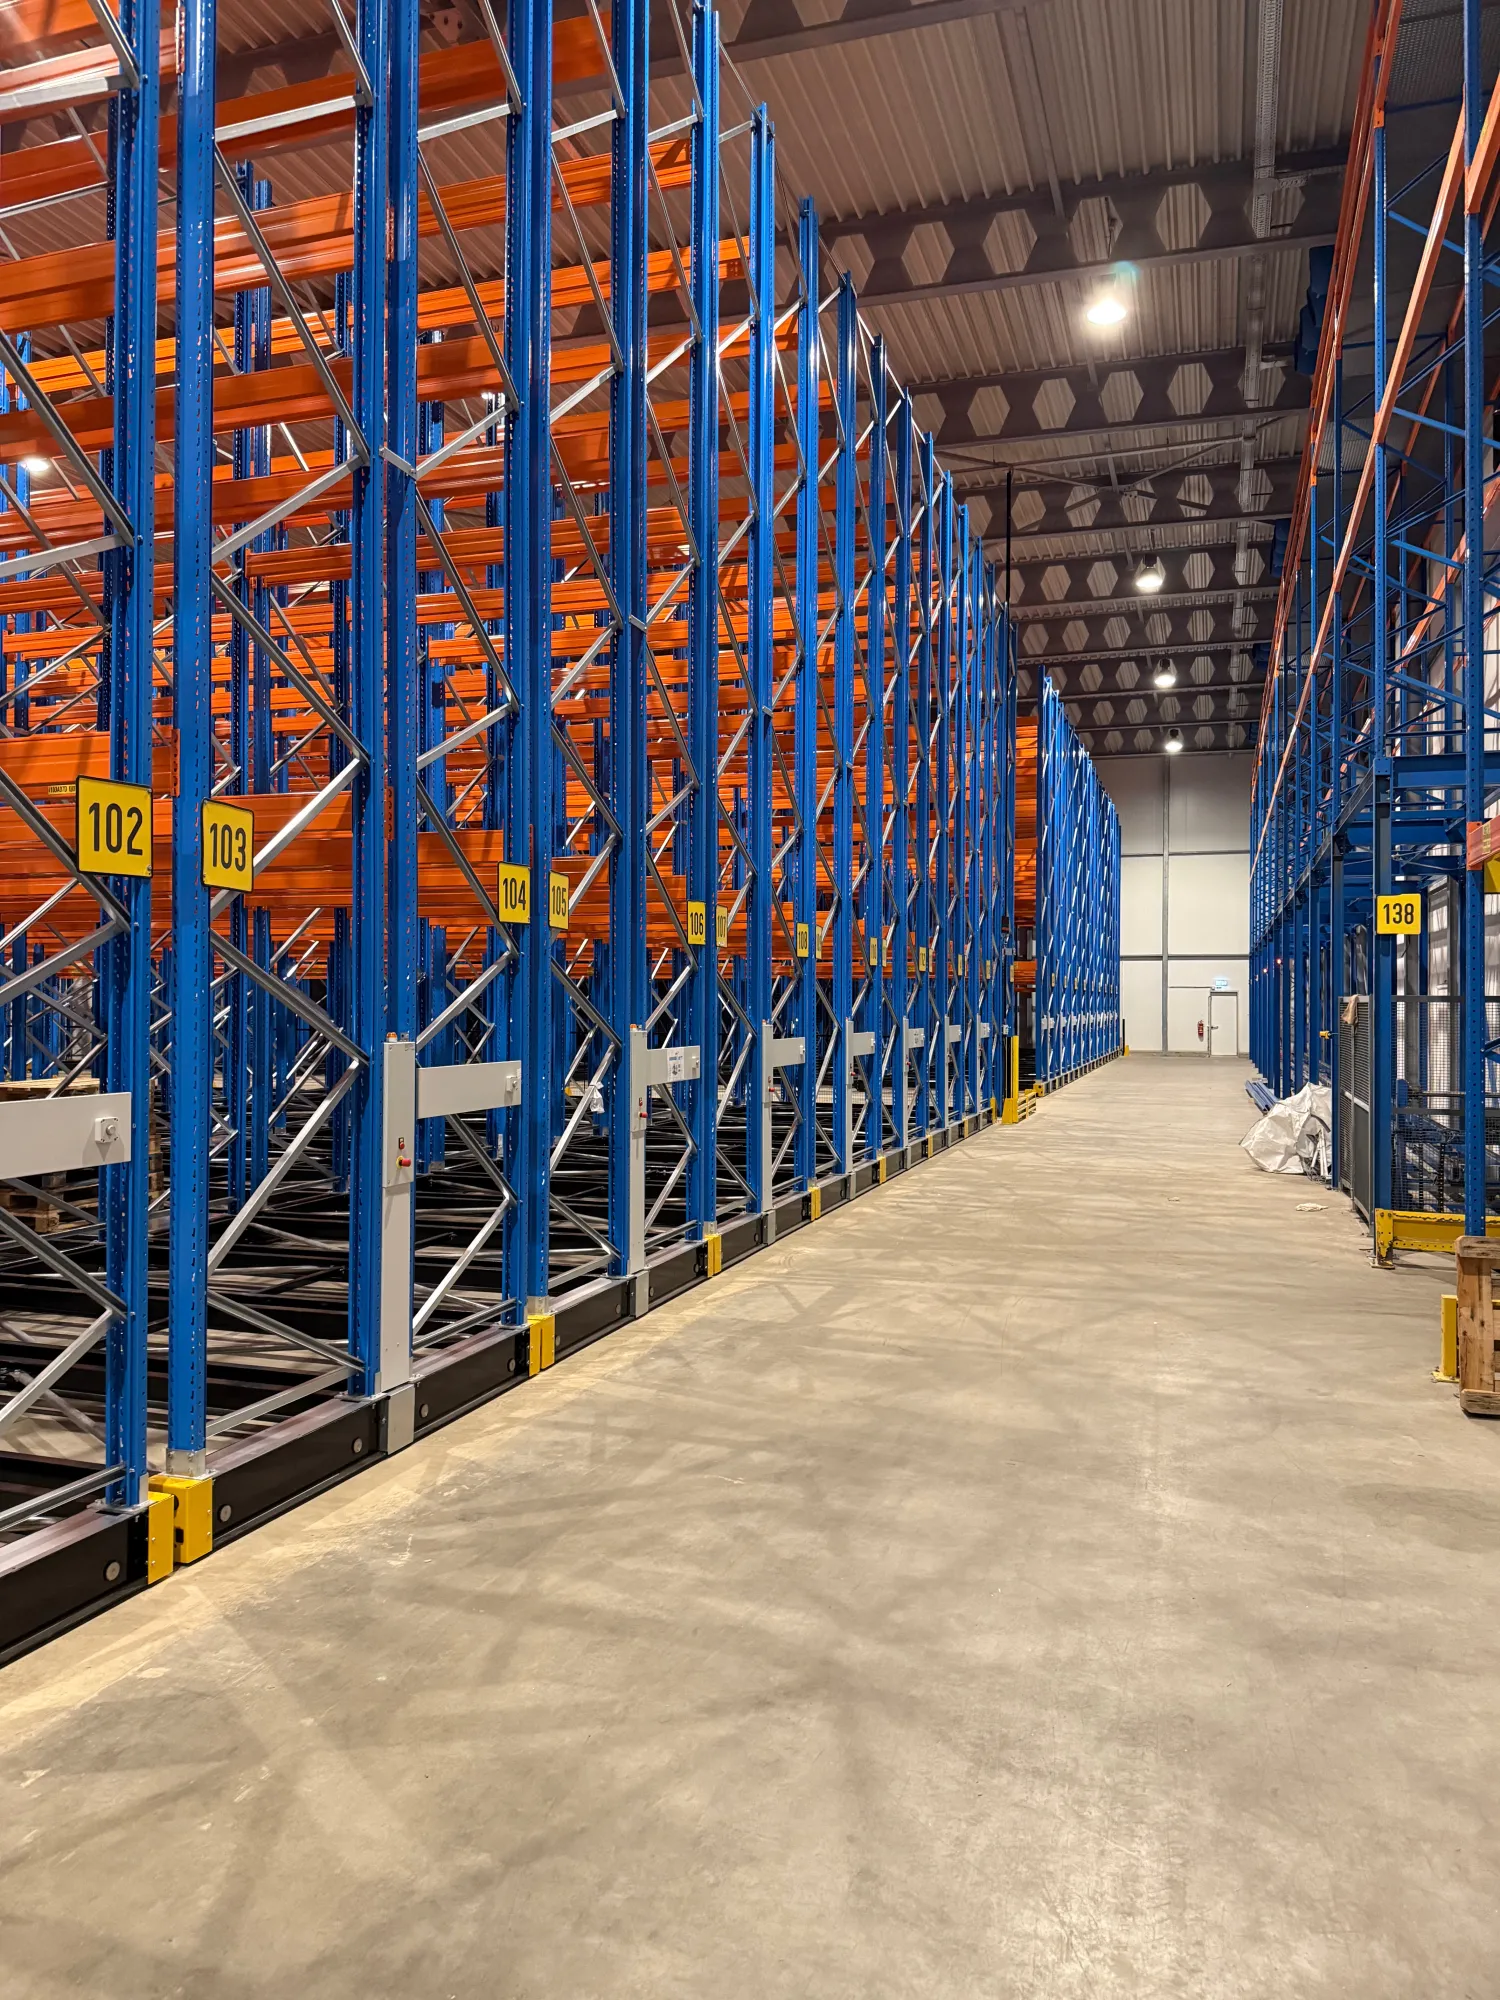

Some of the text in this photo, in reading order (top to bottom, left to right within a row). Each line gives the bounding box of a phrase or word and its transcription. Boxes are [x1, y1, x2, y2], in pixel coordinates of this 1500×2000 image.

[88, 802, 143, 856] 102
[210, 823, 246, 871] 103
[502, 877, 526, 911] 104
[551, 885, 567, 917] 105
[690, 912, 704, 936] 106
[1383, 903, 1413, 924] 138
